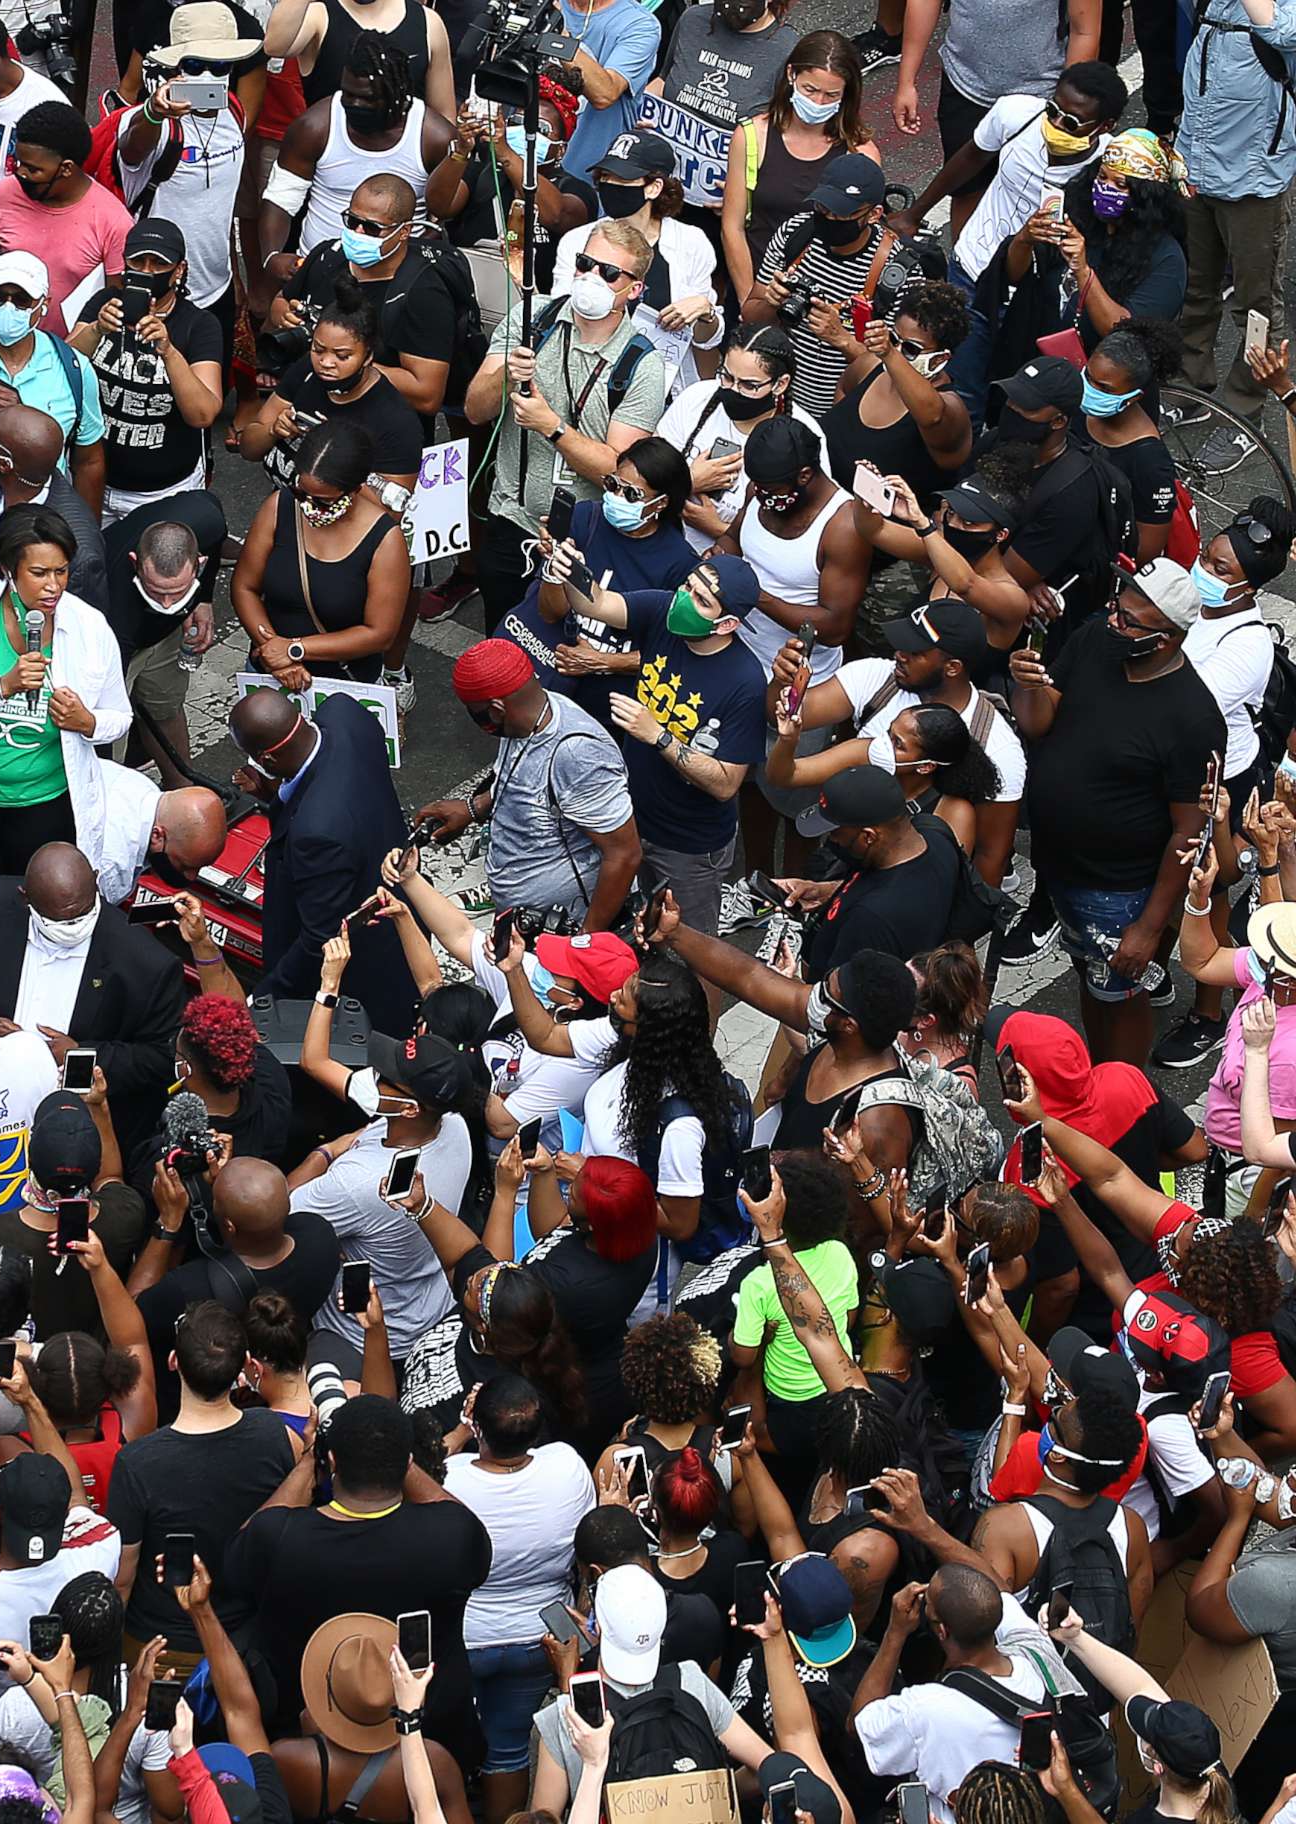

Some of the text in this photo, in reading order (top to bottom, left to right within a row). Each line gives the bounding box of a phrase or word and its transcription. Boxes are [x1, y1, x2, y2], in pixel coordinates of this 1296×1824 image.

[698, 49, 720, 64] WASH
[728, 60, 754, 79] HANDS
[640, 94, 733, 158] BUNKE
[425, 522, 468, 557] D.C.
[636, 663, 699, 745] 202
[612, 1786, 669, 1817] KNOW
